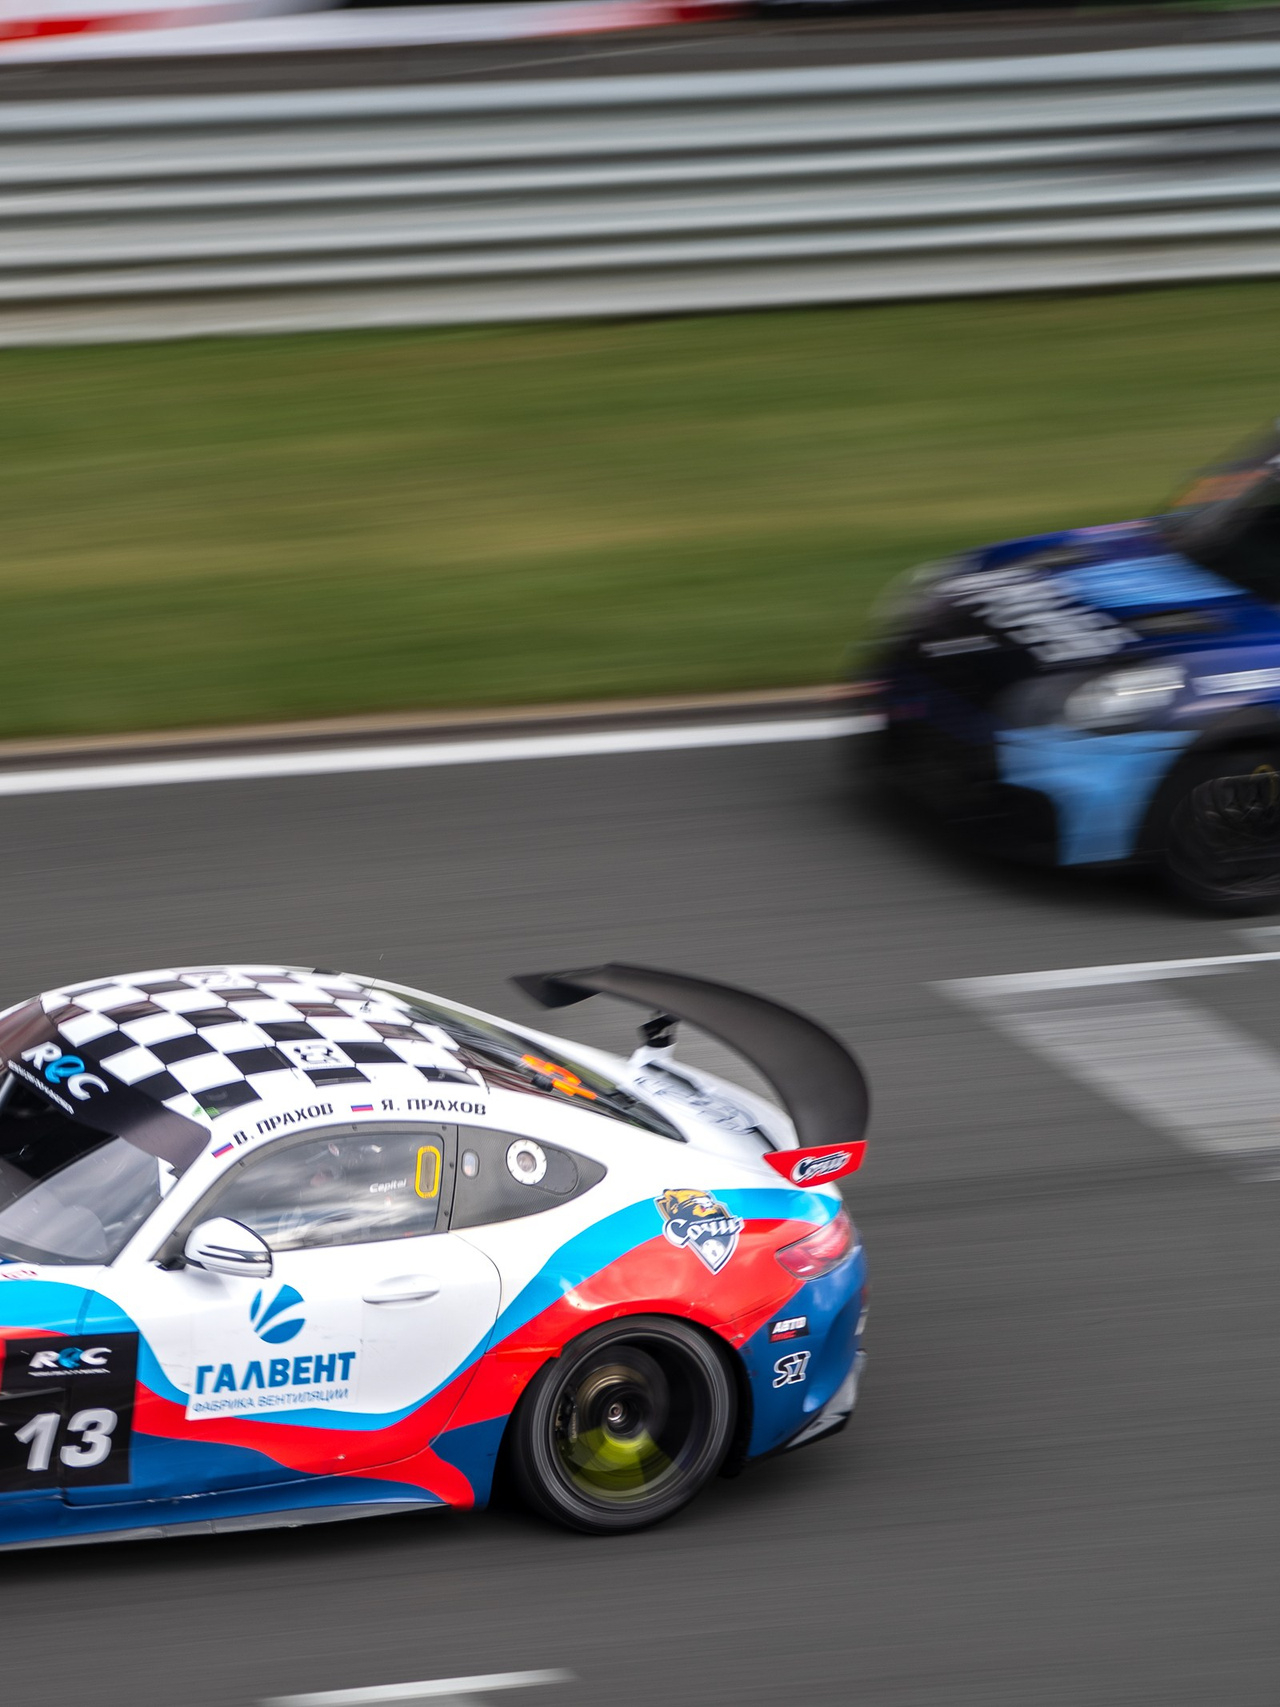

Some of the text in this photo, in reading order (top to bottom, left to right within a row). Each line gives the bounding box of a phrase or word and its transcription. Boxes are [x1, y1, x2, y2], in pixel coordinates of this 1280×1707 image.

[256, 1103, 334, 1135] ПРАХОВ
[407, 1099, 487, 1115] ПРАХОВ
[195, 1351, 356, 1395] ГАЛВЕНТ
[192, 1388, 349, 1412] ФАБРИКА ВЕНТИЛЯЦИИ
[15, 1408, 117, 1471] 13
